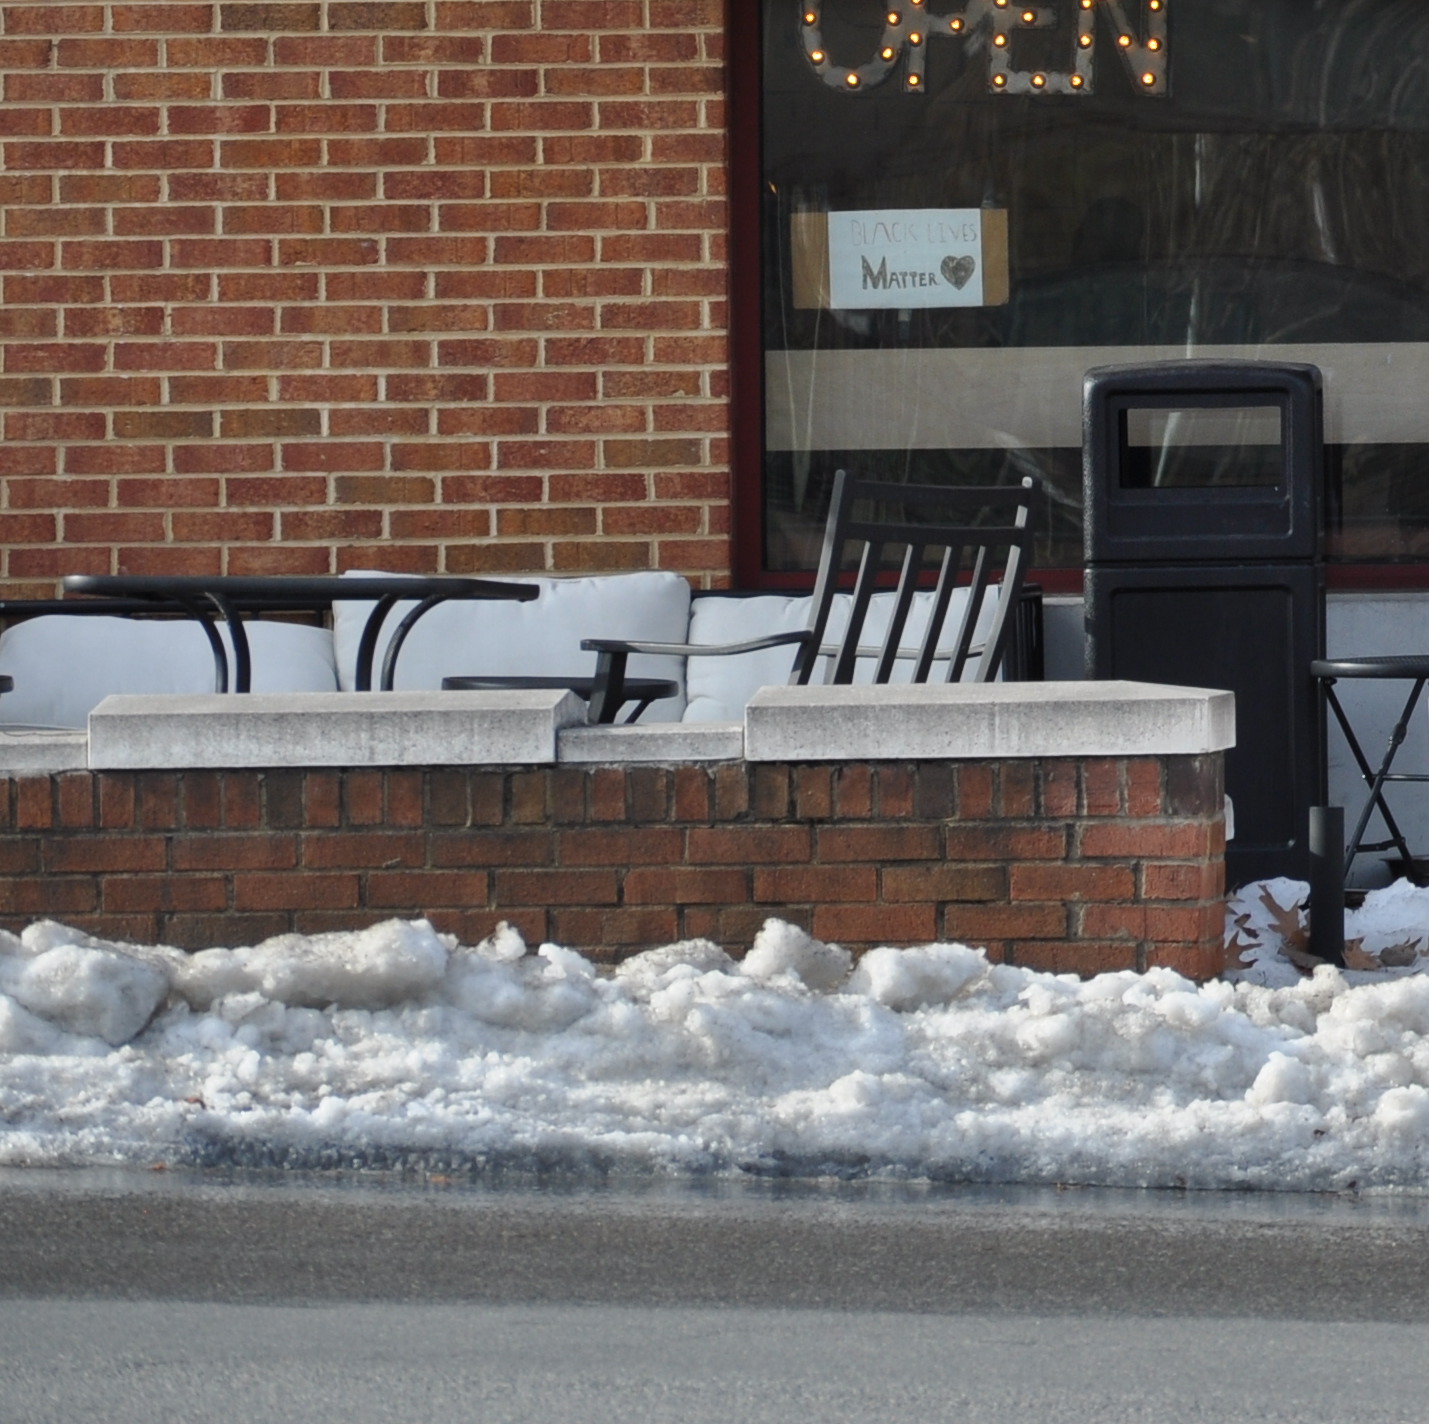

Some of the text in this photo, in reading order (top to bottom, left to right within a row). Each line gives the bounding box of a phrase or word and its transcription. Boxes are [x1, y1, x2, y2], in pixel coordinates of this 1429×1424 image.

[851, 219, 977, 247] BLACK LIVES
[860, 254, 938, 290] MATTER
